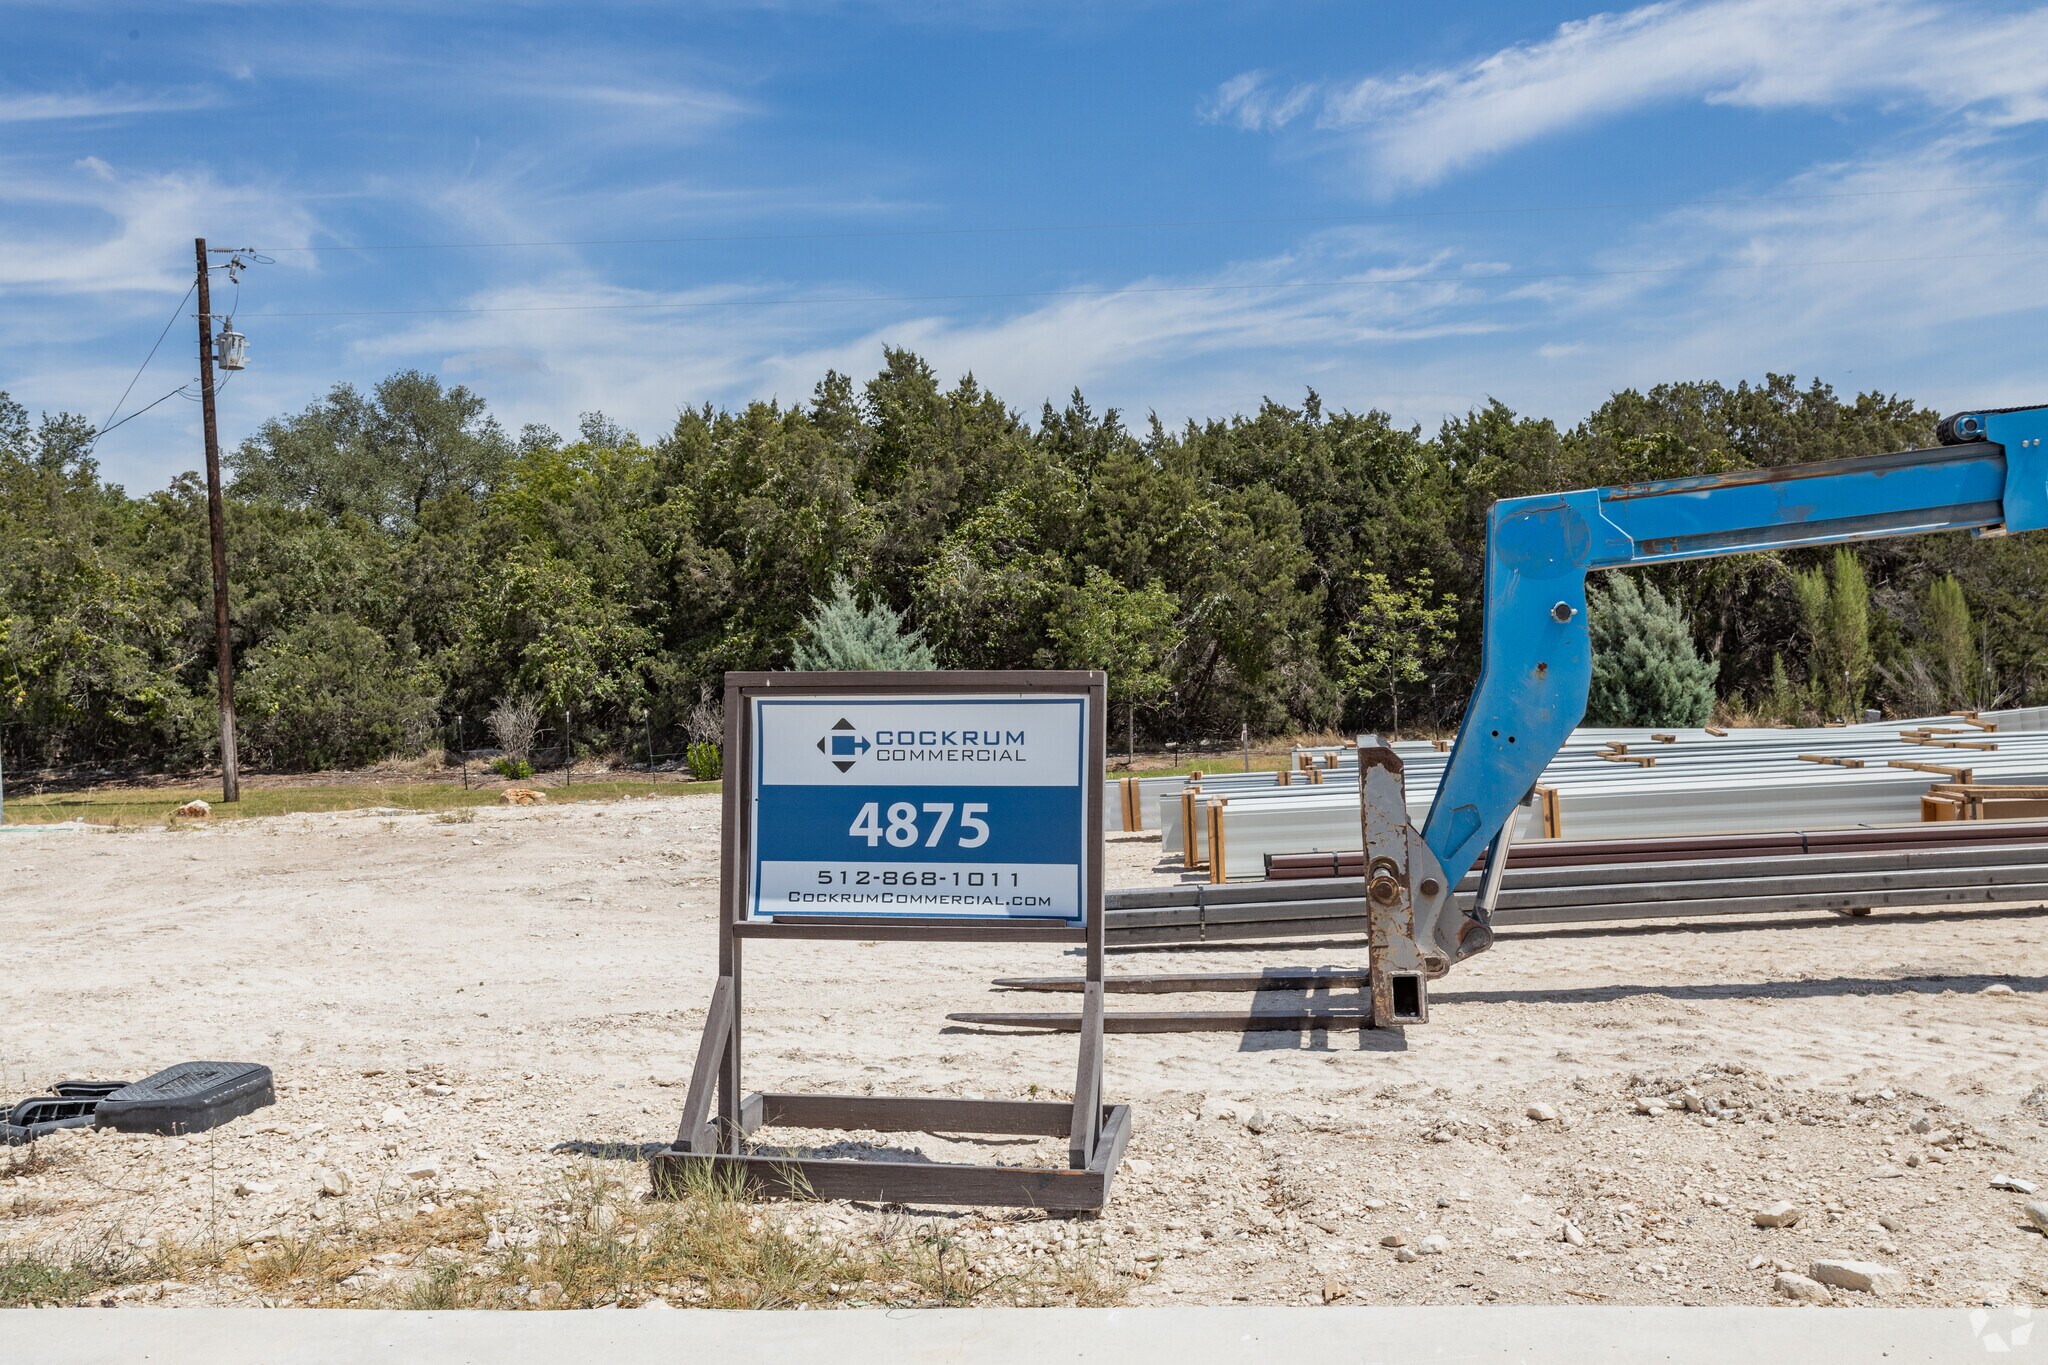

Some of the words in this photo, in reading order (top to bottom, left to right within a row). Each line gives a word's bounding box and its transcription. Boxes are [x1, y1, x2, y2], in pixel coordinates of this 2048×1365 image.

[876, 730, 1025, 746] COCKRUM
[876, 749, 1027, 762] COMMERCIAL
[849, 802, 990, 848] 4875
[818, 870, 1019, 887] 512-868-1011
